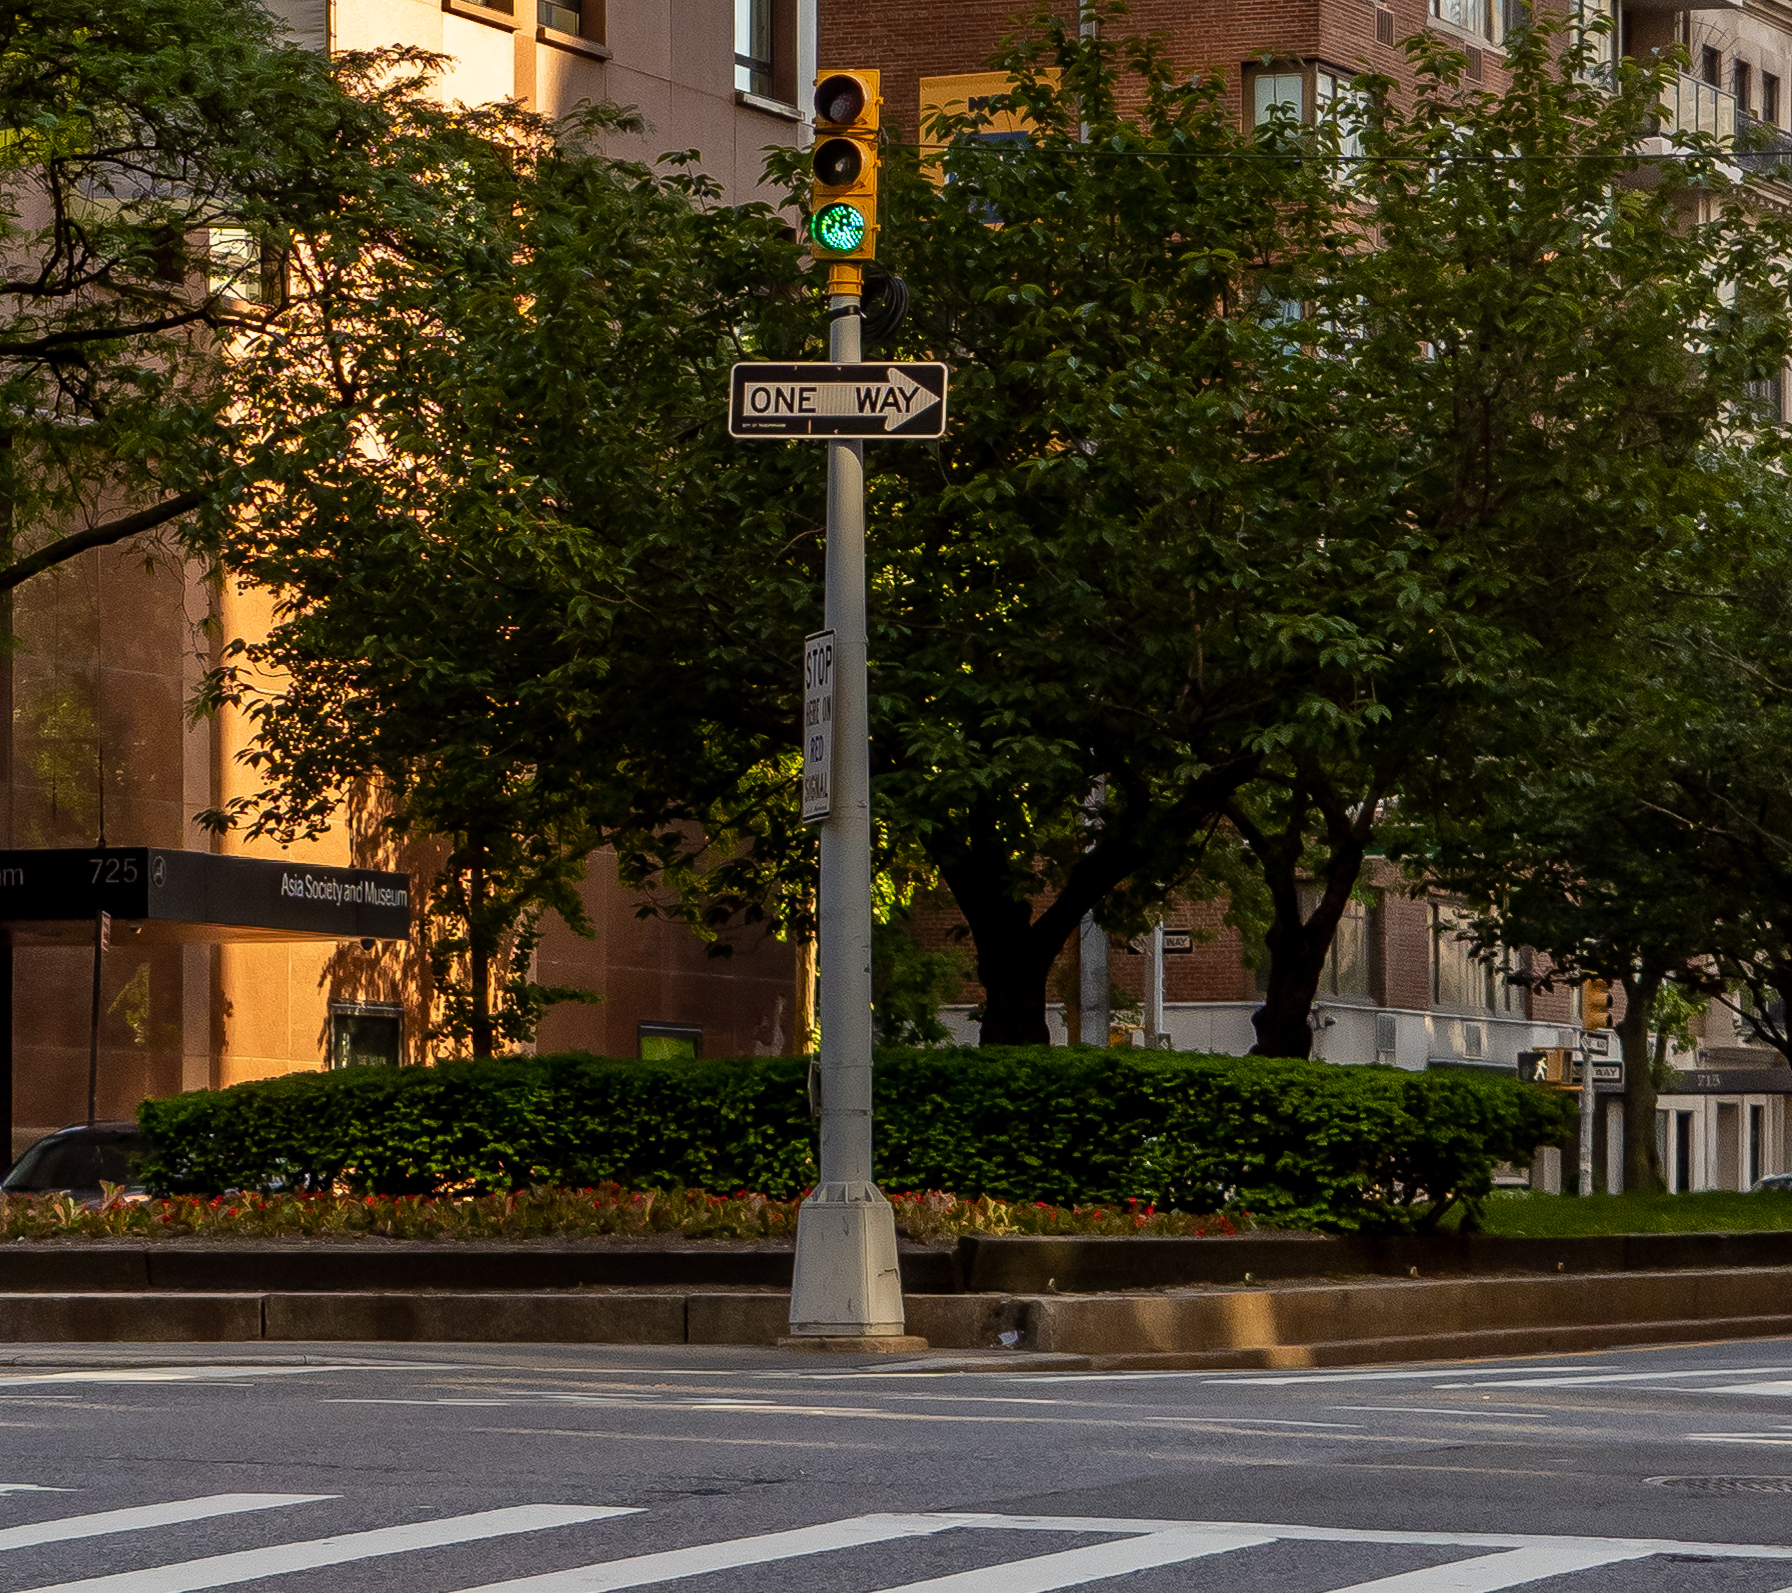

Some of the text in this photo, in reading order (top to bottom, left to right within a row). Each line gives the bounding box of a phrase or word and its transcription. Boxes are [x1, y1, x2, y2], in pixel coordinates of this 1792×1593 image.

[750, 386, 921, 414] ONE WAY
[806, 645, 832, 690] STOP
[810, 734, 824, 763] RED
[89, 858, 138, 884] 725
[281, 872, 408, 907] Asia Society and Museum
